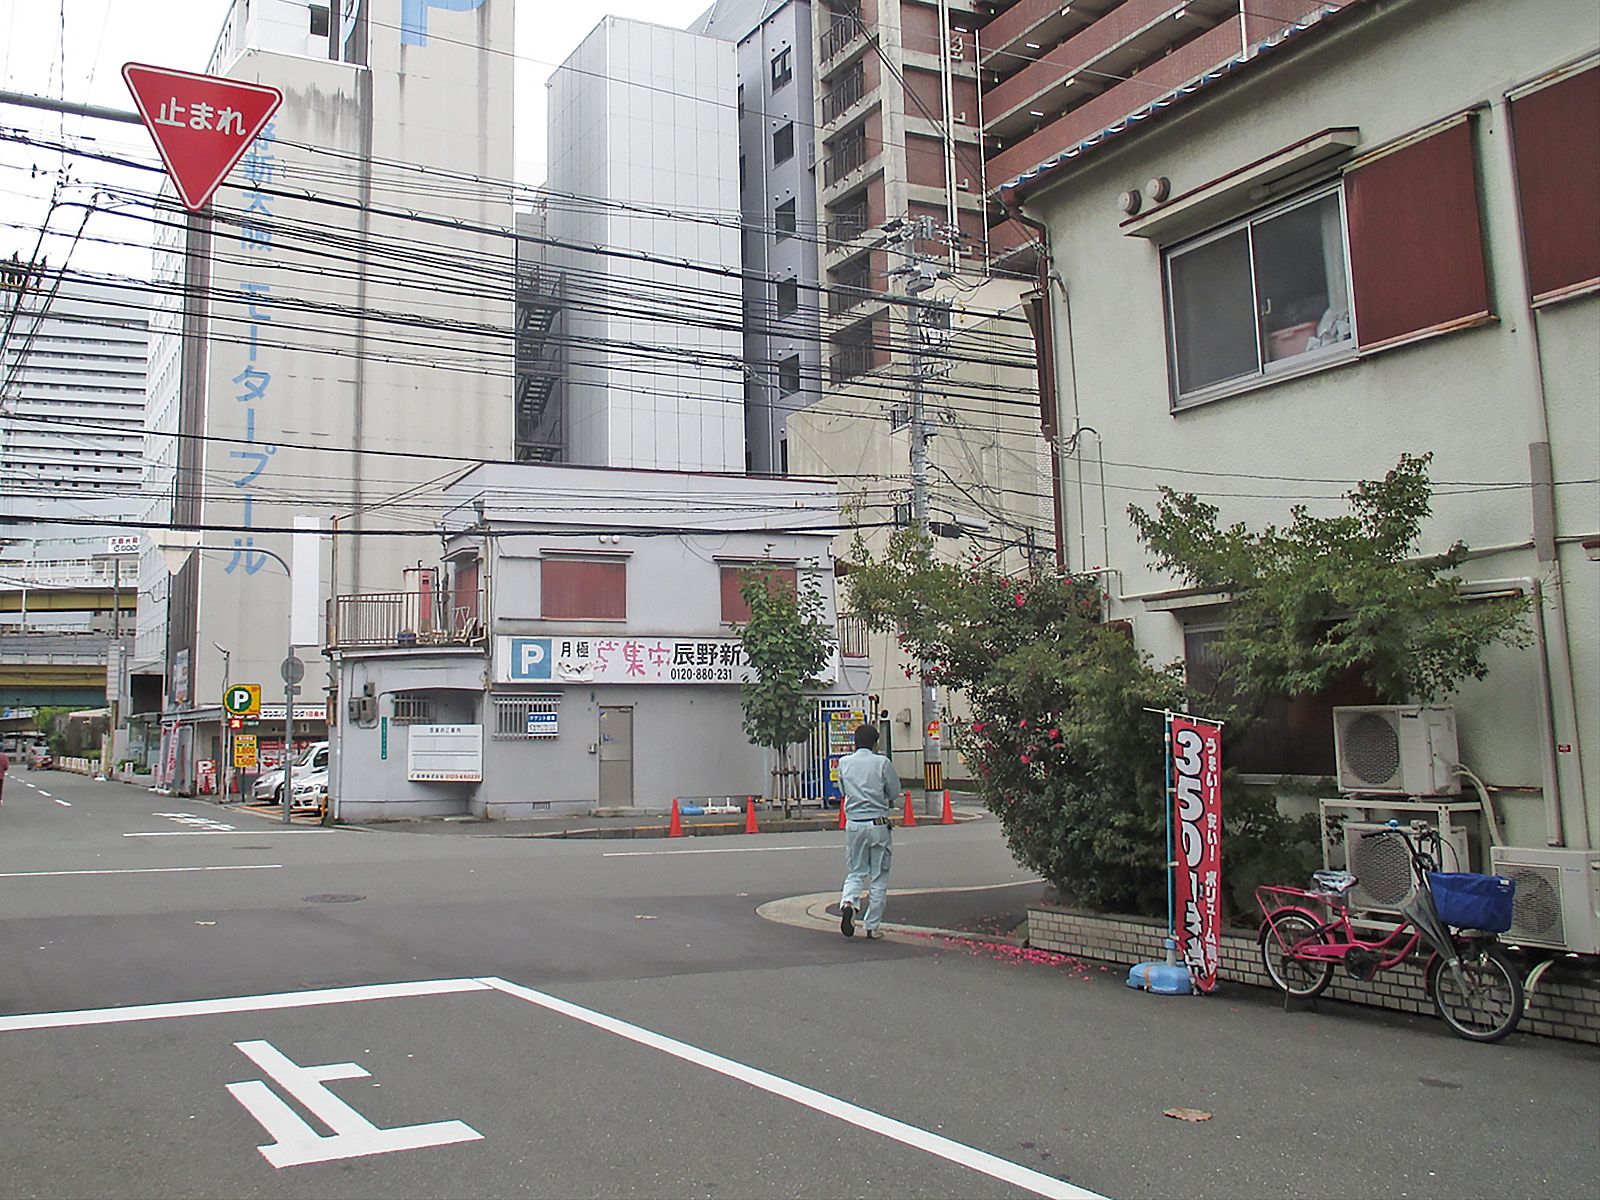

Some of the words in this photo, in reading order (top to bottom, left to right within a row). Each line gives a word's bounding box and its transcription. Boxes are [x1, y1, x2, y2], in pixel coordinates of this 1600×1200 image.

[154, 96, 247, 137] 止まれ
[225, 283, 277, 576] モータープール
[521, 644, 545, 675] P
[560, 641, 590, 658] 月極
[673, 642, 752, 667] 辰野新
[233, 690, 250, 710] P
